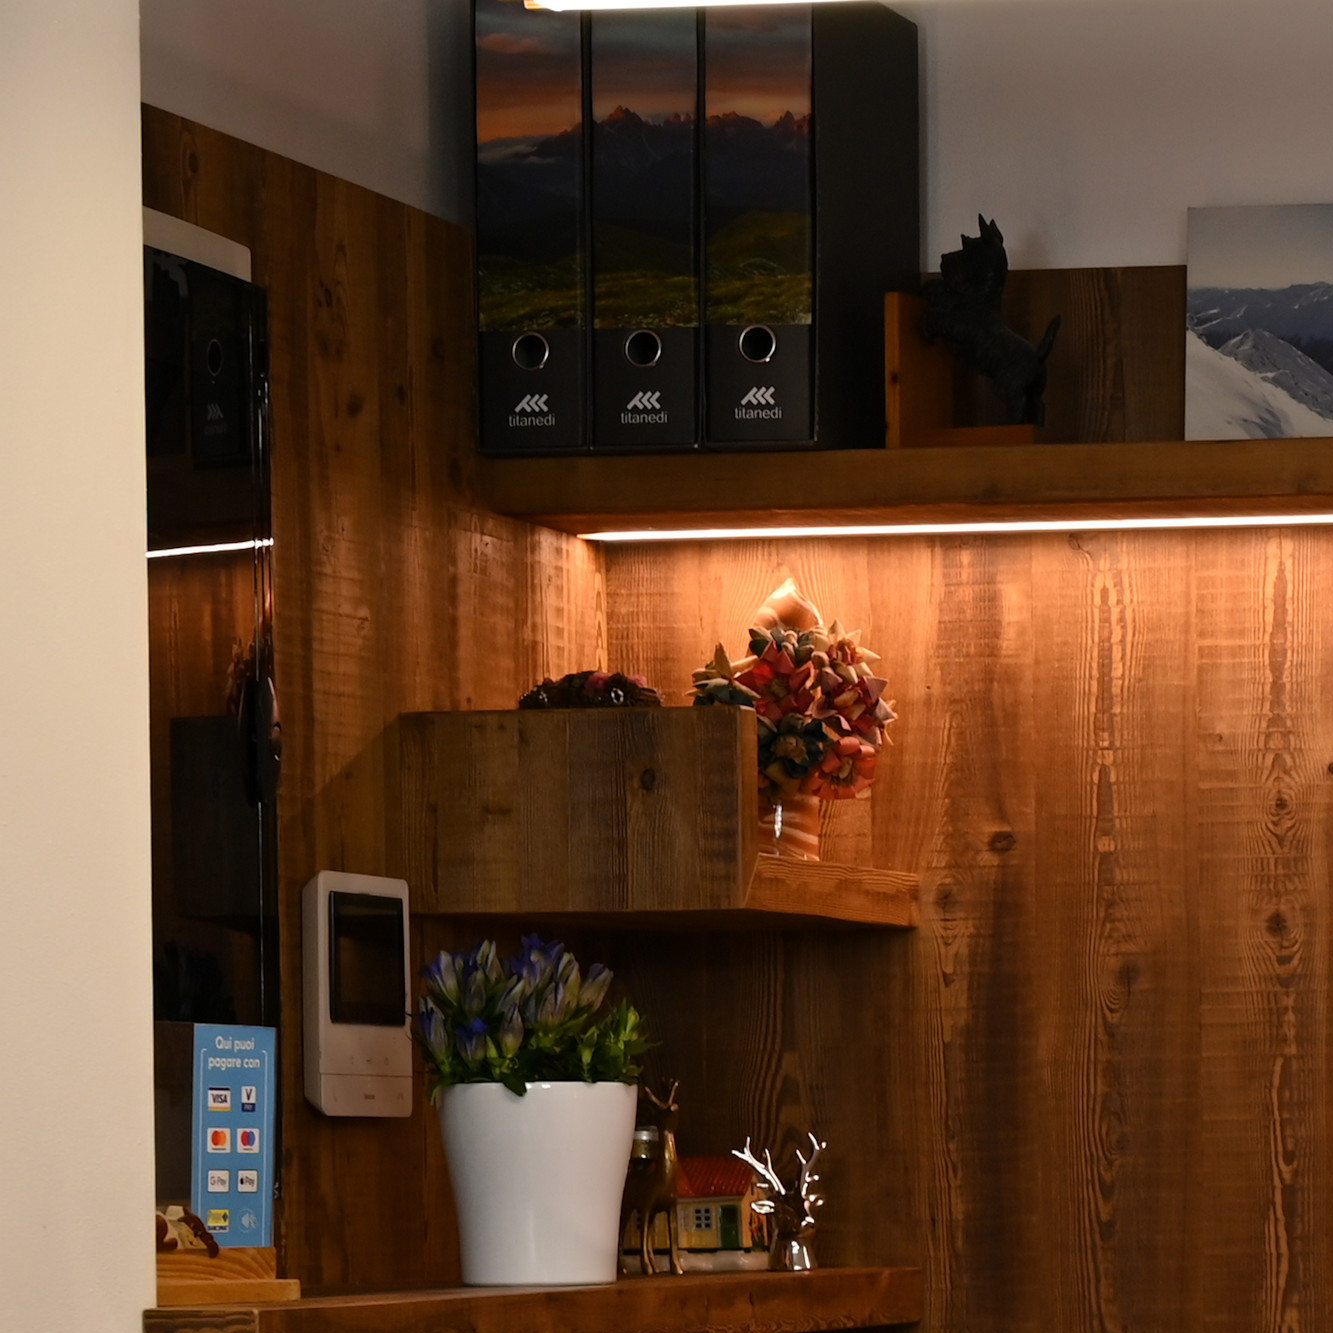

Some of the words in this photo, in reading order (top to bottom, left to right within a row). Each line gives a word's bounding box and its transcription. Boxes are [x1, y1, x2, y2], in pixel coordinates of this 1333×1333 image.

[508, 412, 556, 428] titanedi
[620, 410, 668, 425] titanedi
[734, 406, 782, 420] titanedi
[215, 1035, 233, 1050] Qui
[234, 1036, 255, 1053] puoi
[207, 1056, 242, 1071] pagare
[243, 1058, 260, 1068] con
[211, 1093, 228, 1104] VISA
